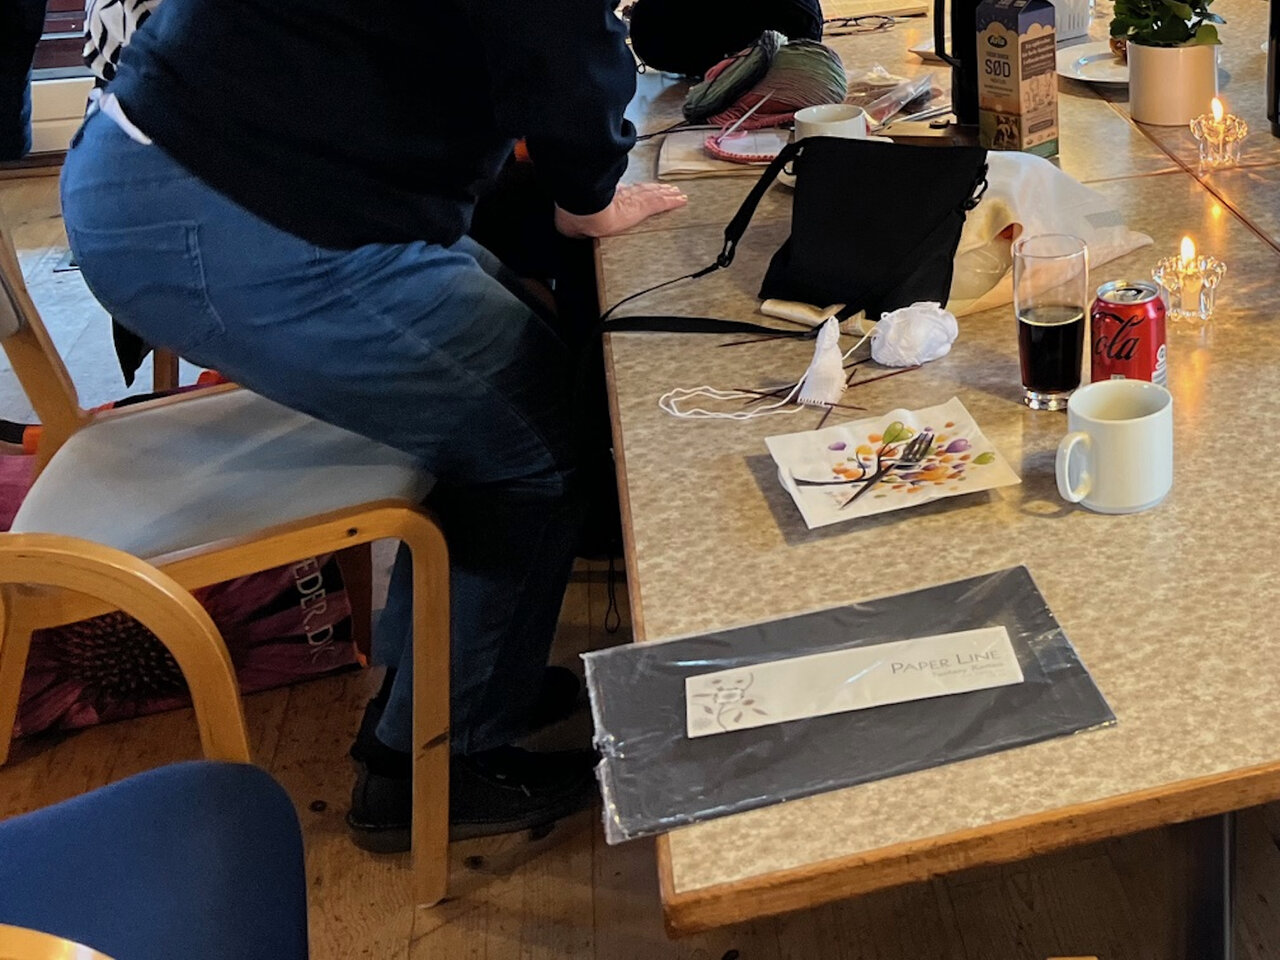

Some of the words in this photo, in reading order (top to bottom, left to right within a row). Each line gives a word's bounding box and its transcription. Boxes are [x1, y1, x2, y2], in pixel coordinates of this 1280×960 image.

[985, 59, 1010, 77] SØD
[890, 659, 949, 674] PAPER
[956, 649, 1001, 665] LINE
